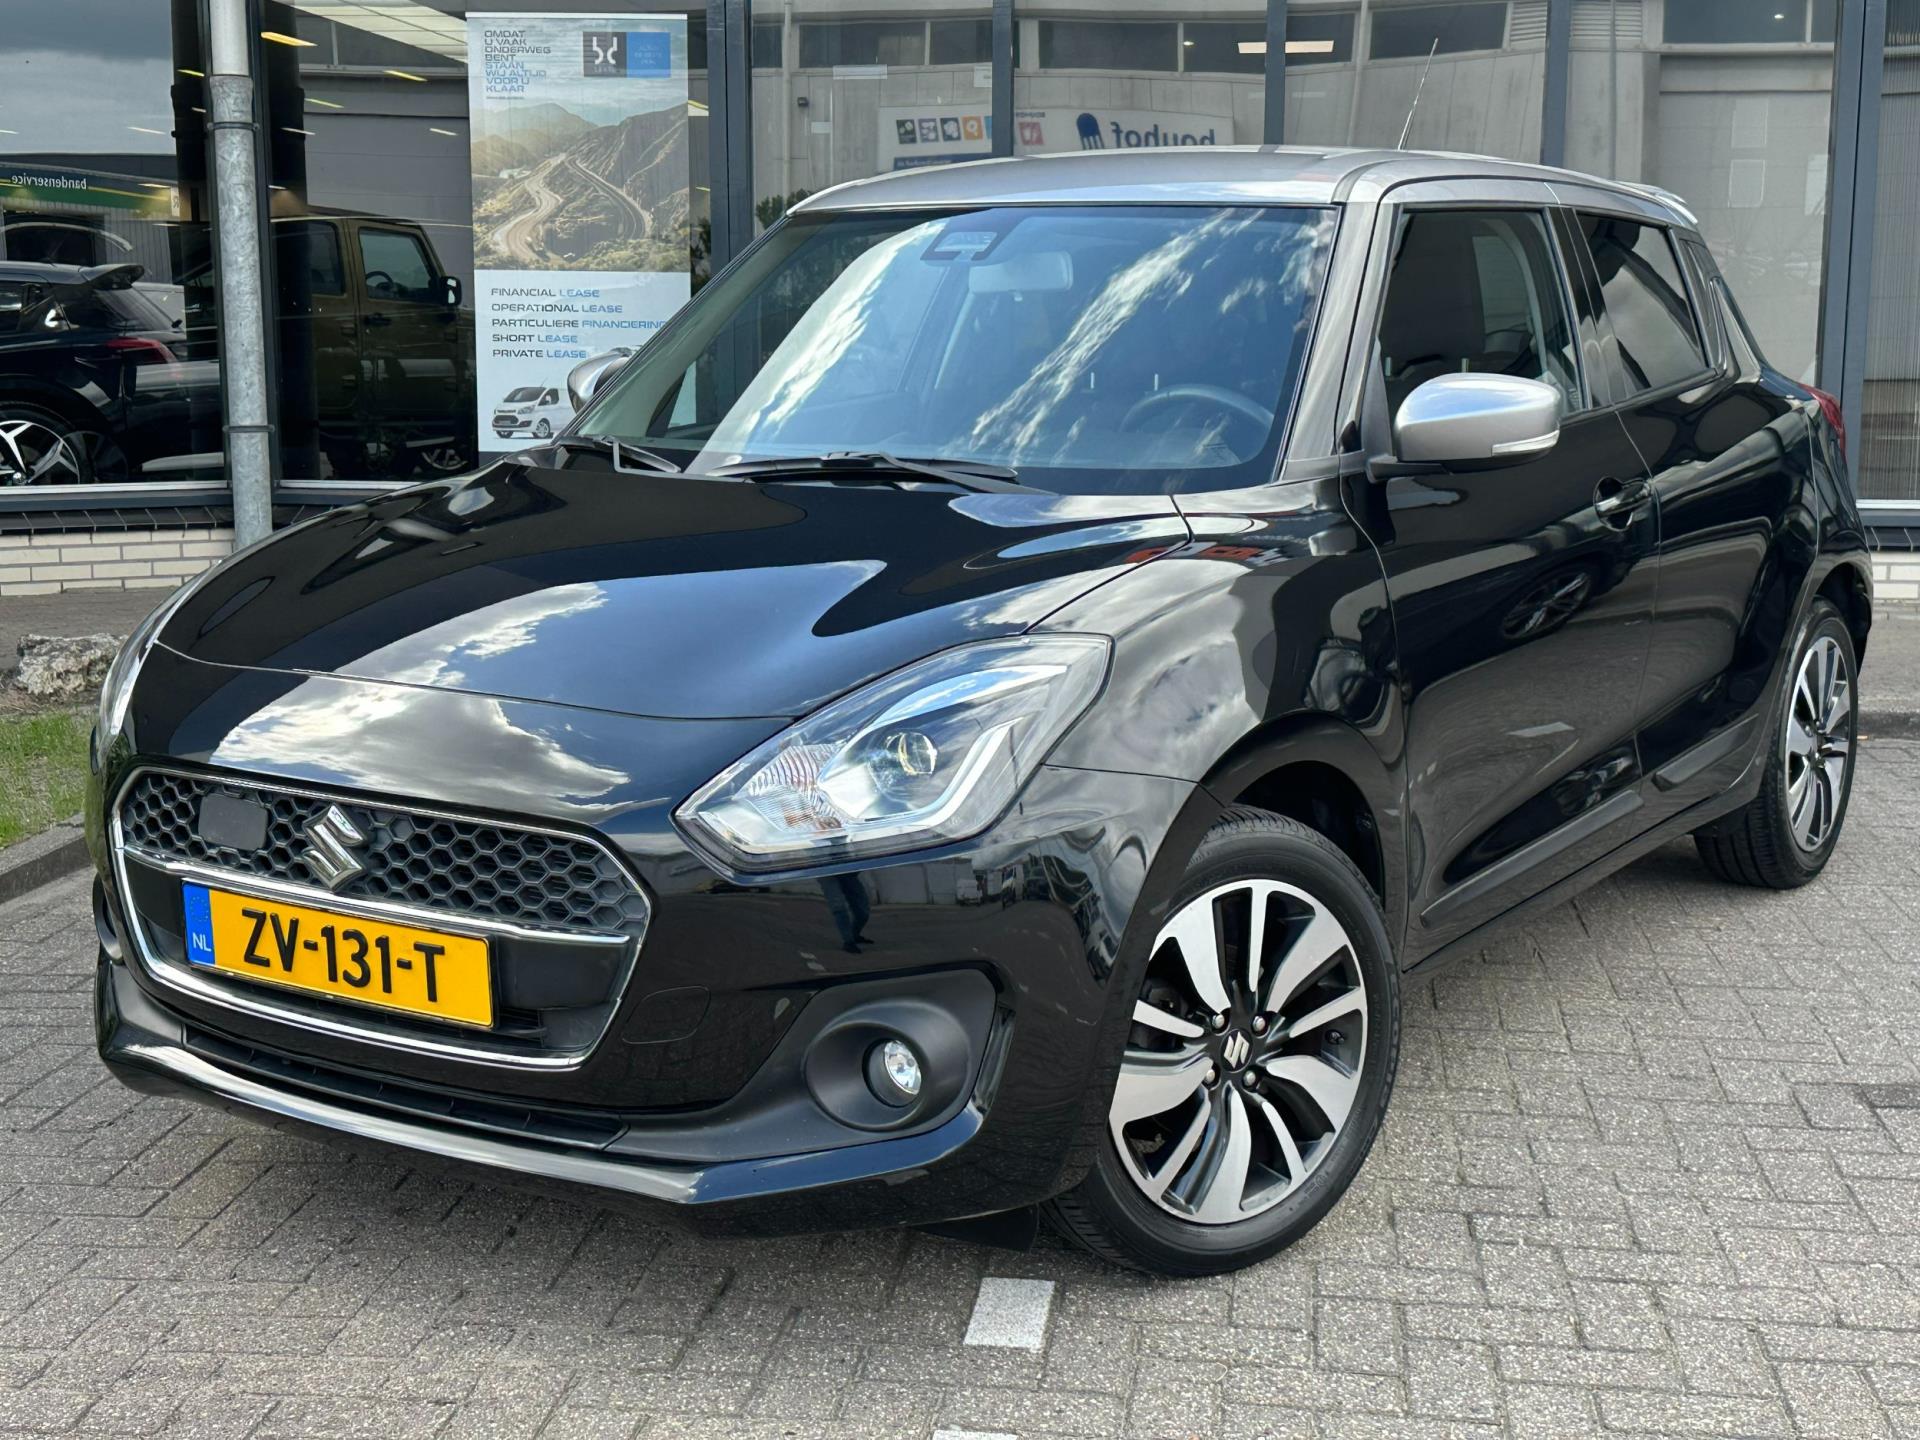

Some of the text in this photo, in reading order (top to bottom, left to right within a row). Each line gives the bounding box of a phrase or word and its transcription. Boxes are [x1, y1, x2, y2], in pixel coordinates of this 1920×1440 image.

[484, 30, 526, 38] OMDAT
[484, 38, 527, 46] U VAAK
[484, 46, 552, 54] ONDERWEG
[485, 61, 524, 69] STAAN
[486, 77, 530, 85] VOOR U
[491, 288, 600, 298] FINANCIAL LEASE
[491, 303, 623, 313] OPERATIONAL LEASE
[492, 318, 579, 328] PARTICULIERE
[492, 333, 578, 344] SHORT LEASE
[492, 349, 587, 359] PRIVATE LEASE
[192, 932, 212, 952] NL
[241, 908, 446, 1003] ZV-131-T
